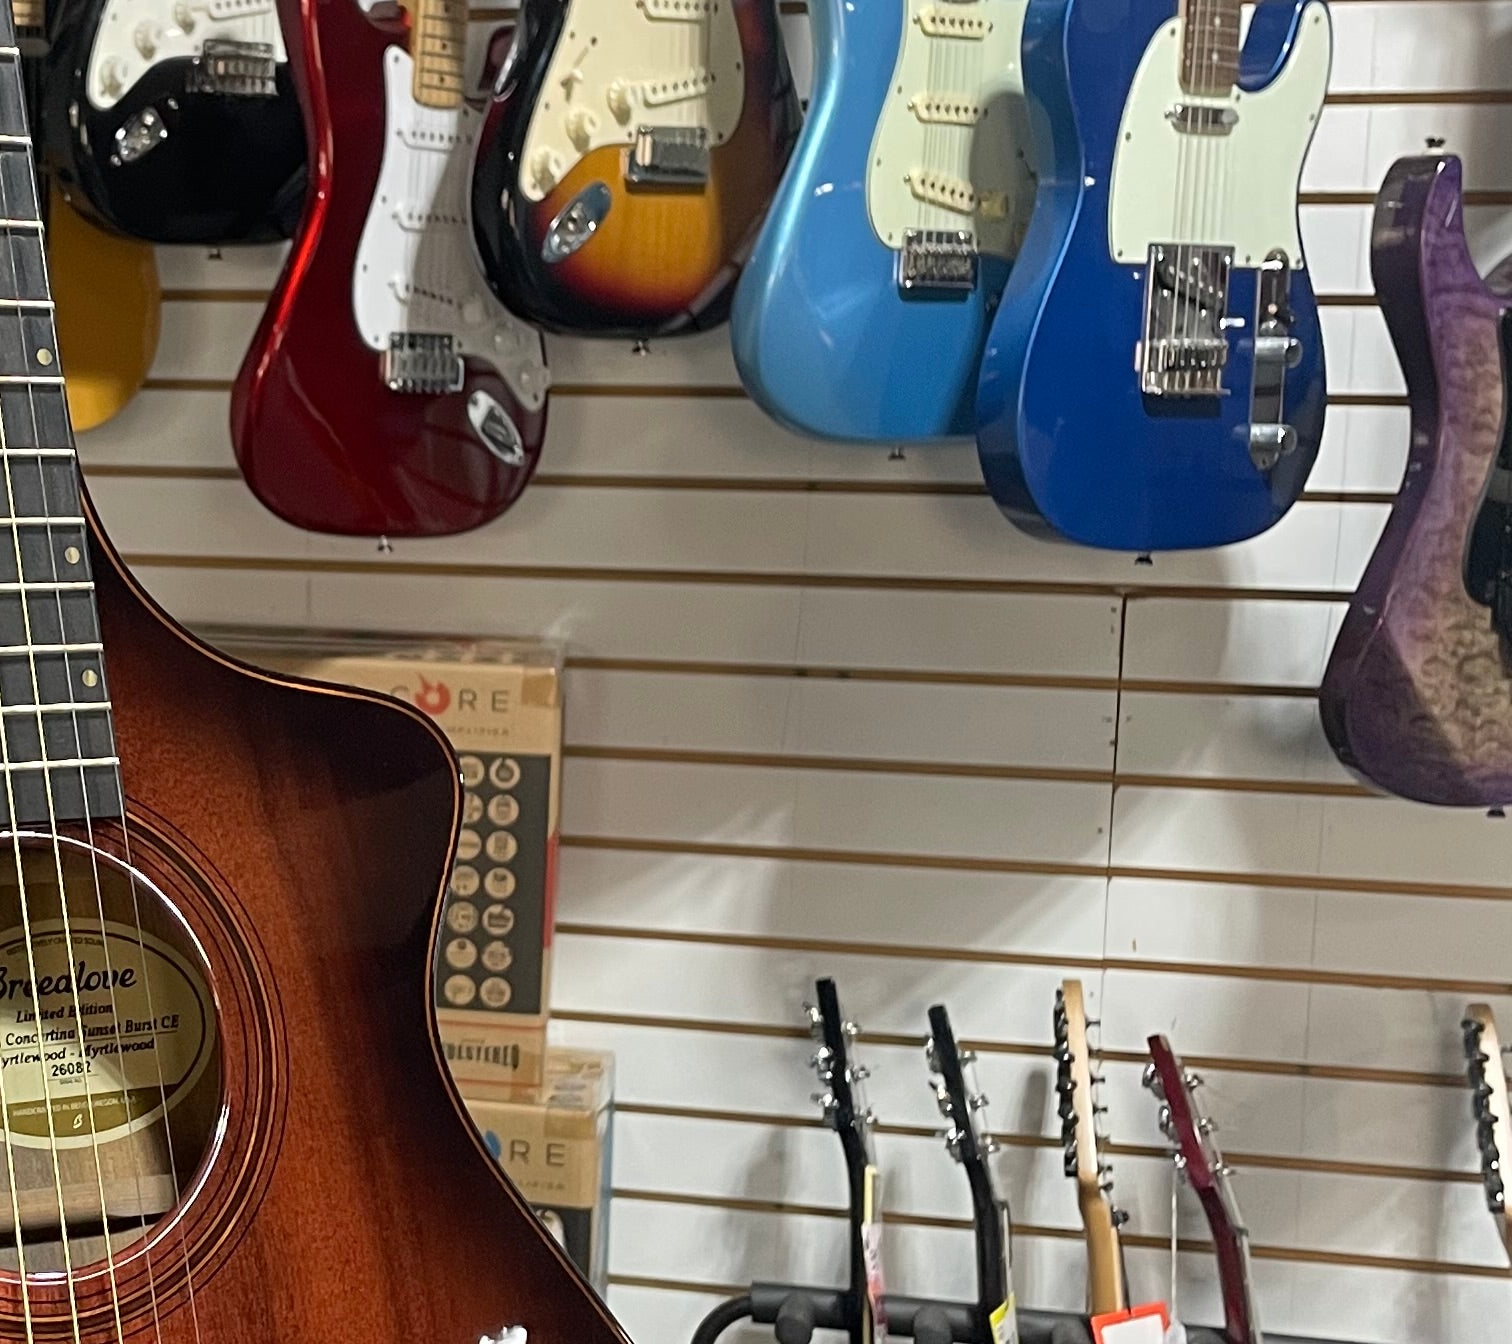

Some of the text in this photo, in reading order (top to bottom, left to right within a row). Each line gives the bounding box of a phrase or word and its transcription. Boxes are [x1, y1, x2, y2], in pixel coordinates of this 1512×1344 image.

[5, 1026, 76, 1049] Concrtina
[124, 1017, 158, 1034] Burst
[161, 1014, 181, 1029] CE
